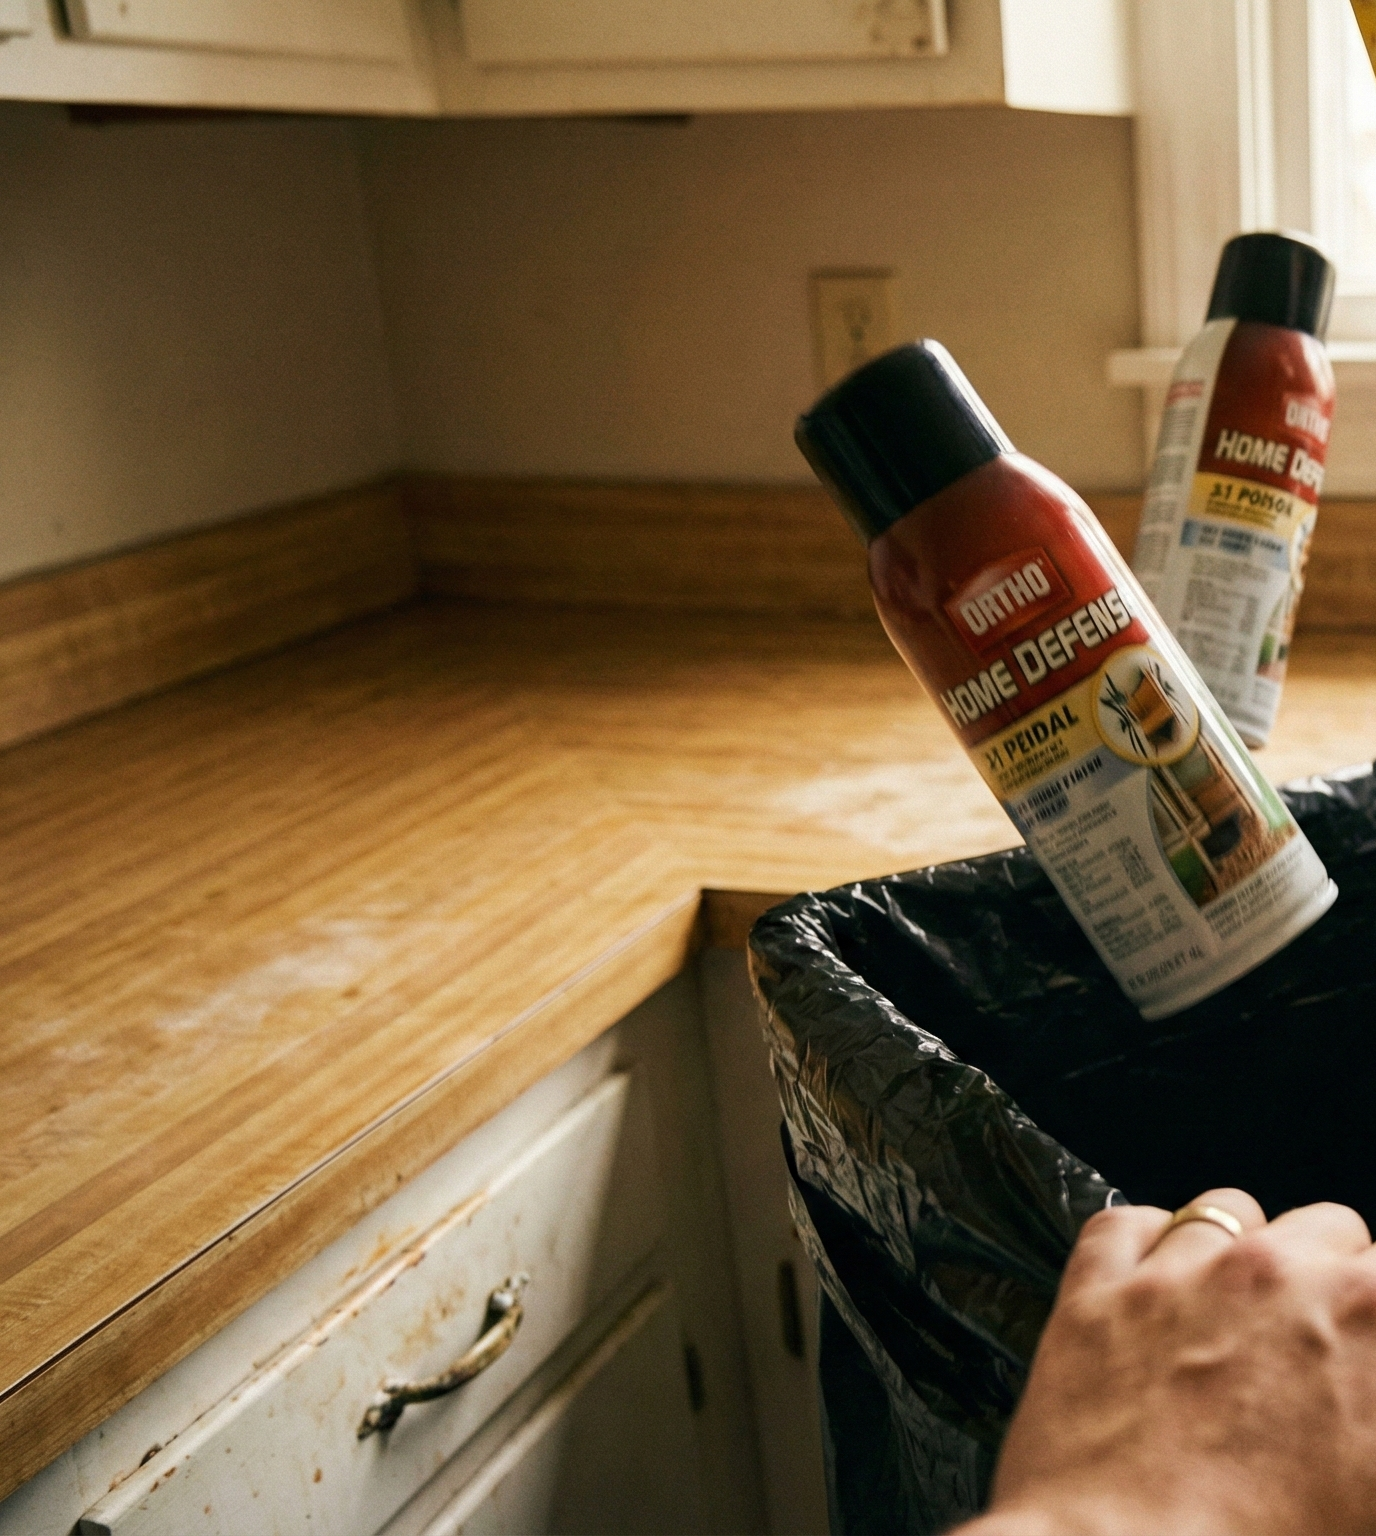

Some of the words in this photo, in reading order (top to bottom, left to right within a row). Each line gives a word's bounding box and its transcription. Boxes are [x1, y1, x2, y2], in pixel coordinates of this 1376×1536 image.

[1214, 428, 1290, 474] HOME
[959, 561, 1051, 636] ORTHO
[940, 659, 1020, 730] HOME
